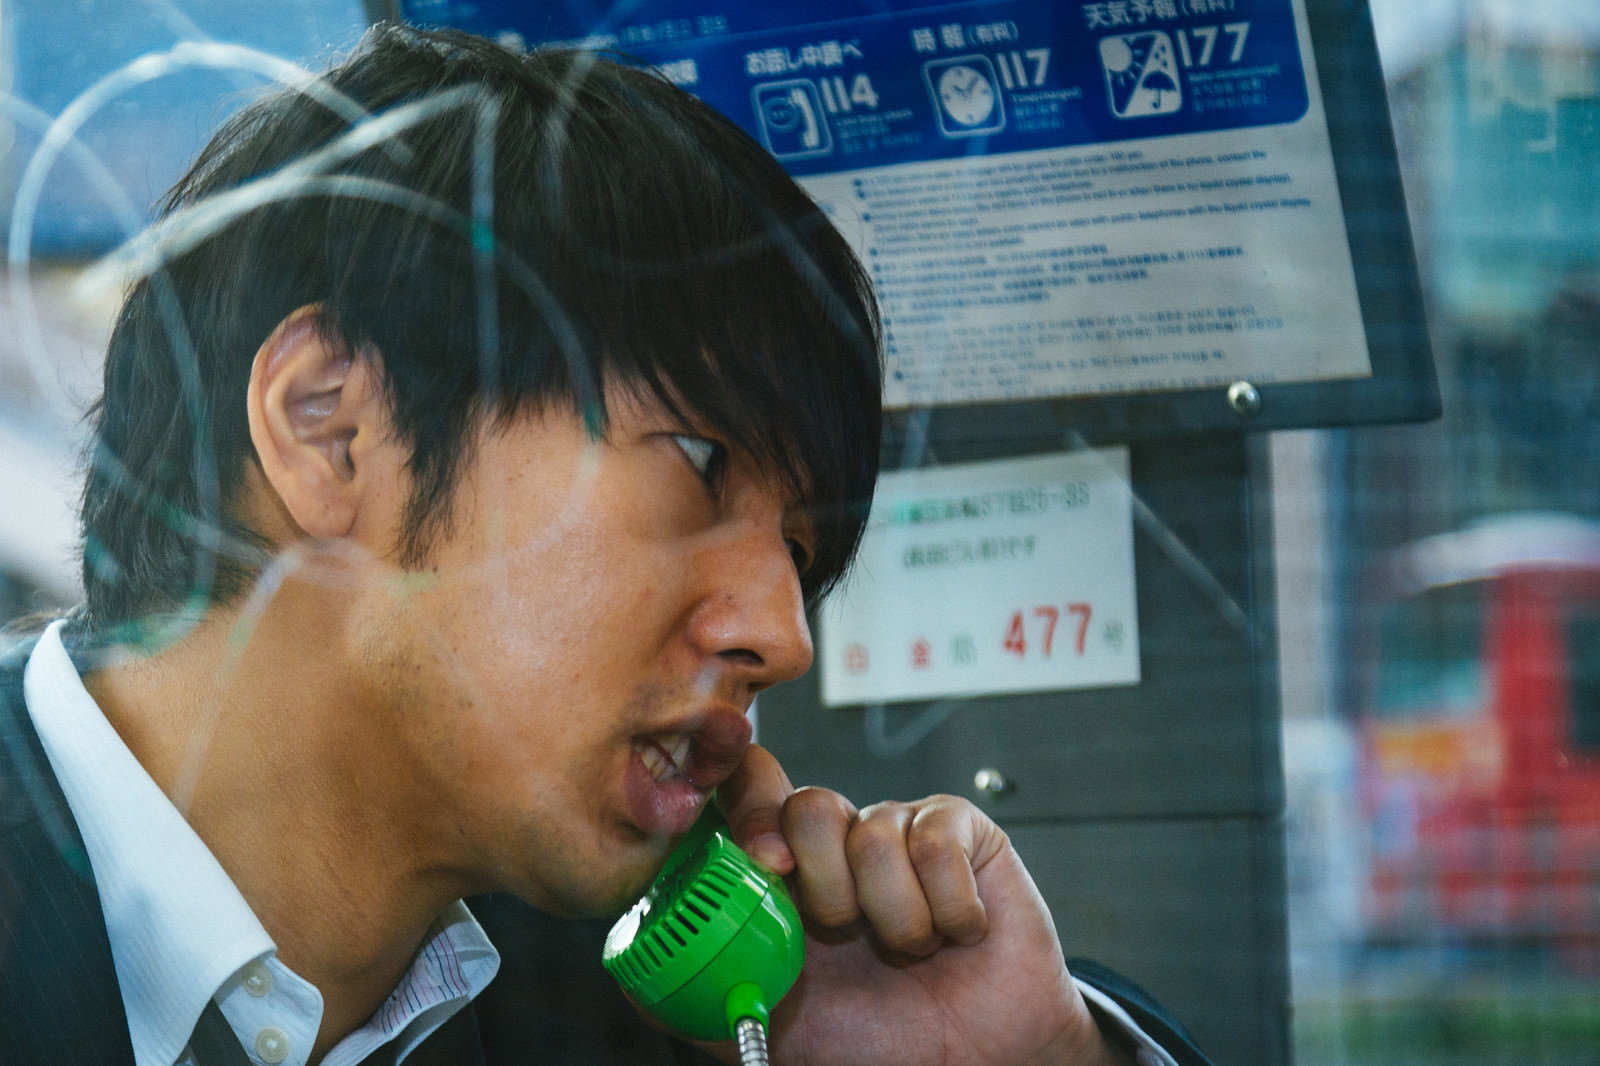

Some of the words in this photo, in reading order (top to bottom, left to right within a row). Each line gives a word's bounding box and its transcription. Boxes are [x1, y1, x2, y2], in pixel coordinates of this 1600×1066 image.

[1176, 21, 1250, 67] 177
[997, 48, 1050, 89] 117
[821, 73, 878, 112] 114
[1003, 602, 1093, 658] 477
